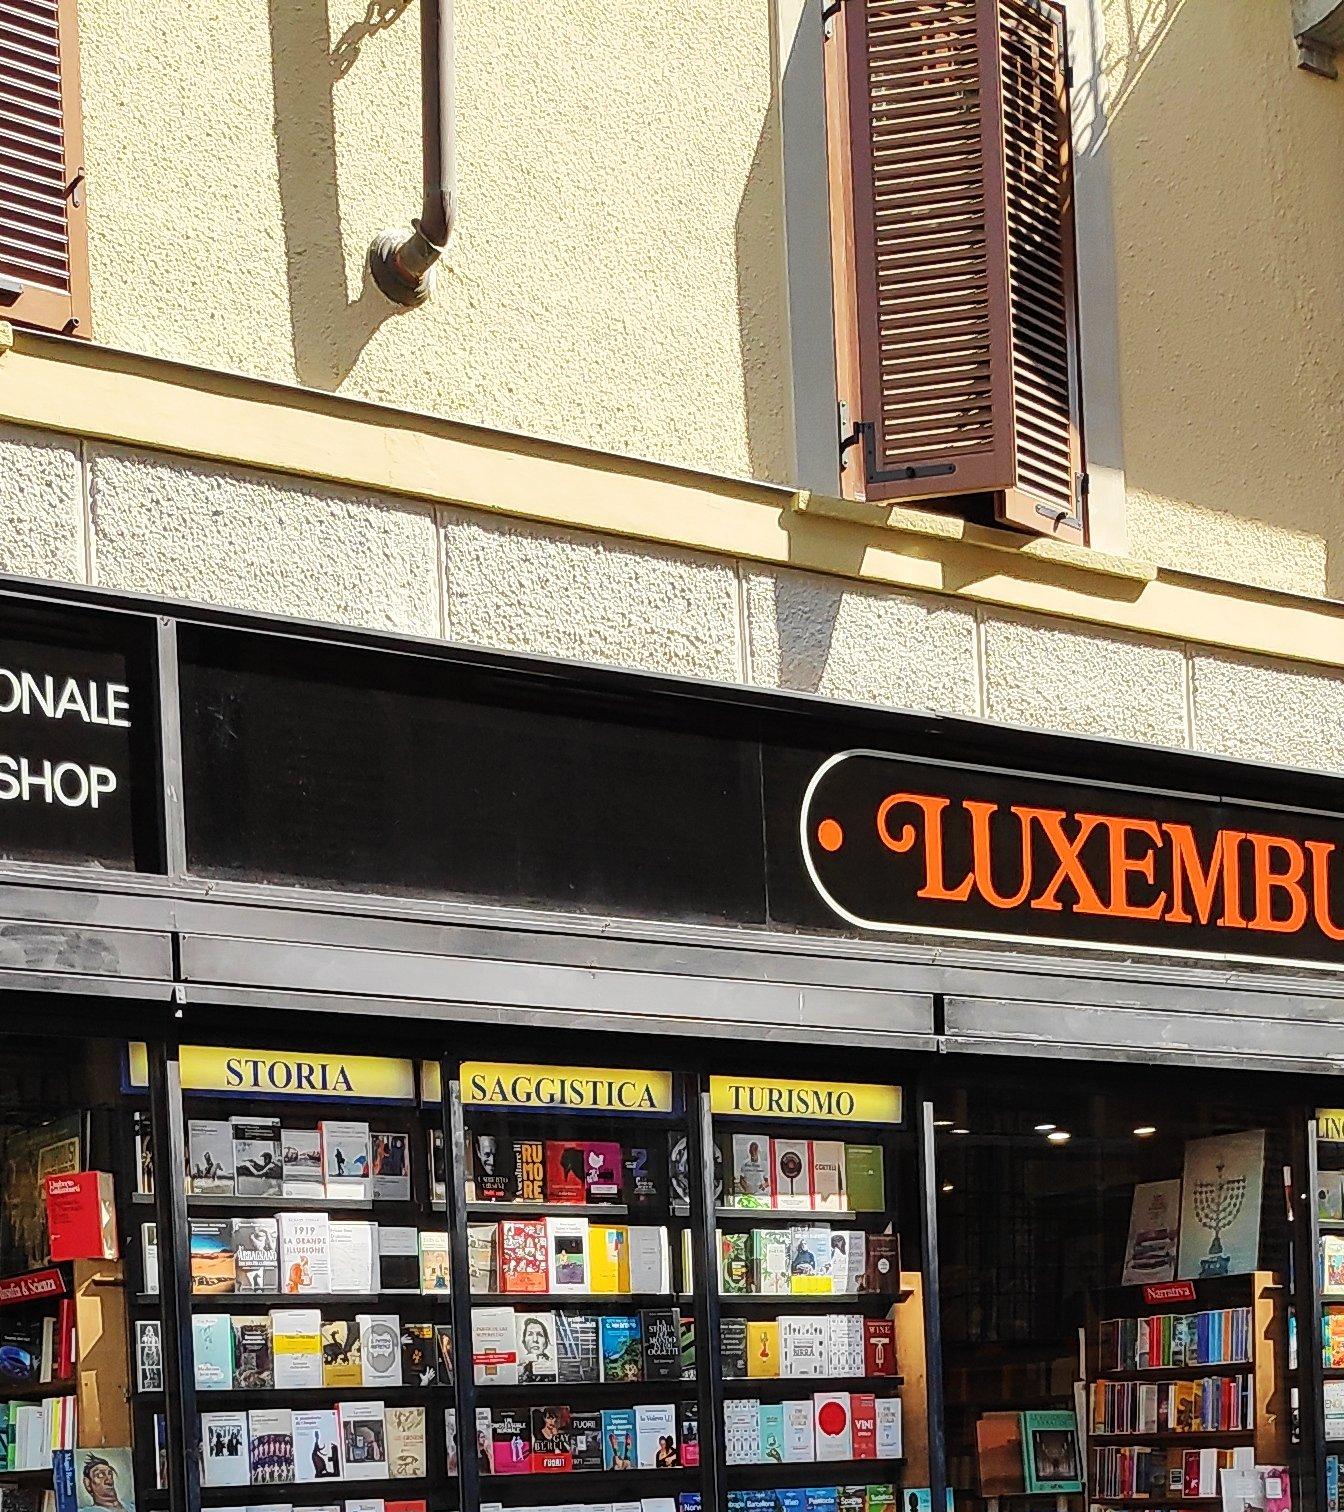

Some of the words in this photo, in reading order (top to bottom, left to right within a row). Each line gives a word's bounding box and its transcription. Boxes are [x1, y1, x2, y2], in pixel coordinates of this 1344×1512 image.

[225, 1057, 355, 1092] STORIA
[471, 1074, 658, 1109] SAGGISTICA
[728, 1085, 855, 1116] TURISMO
